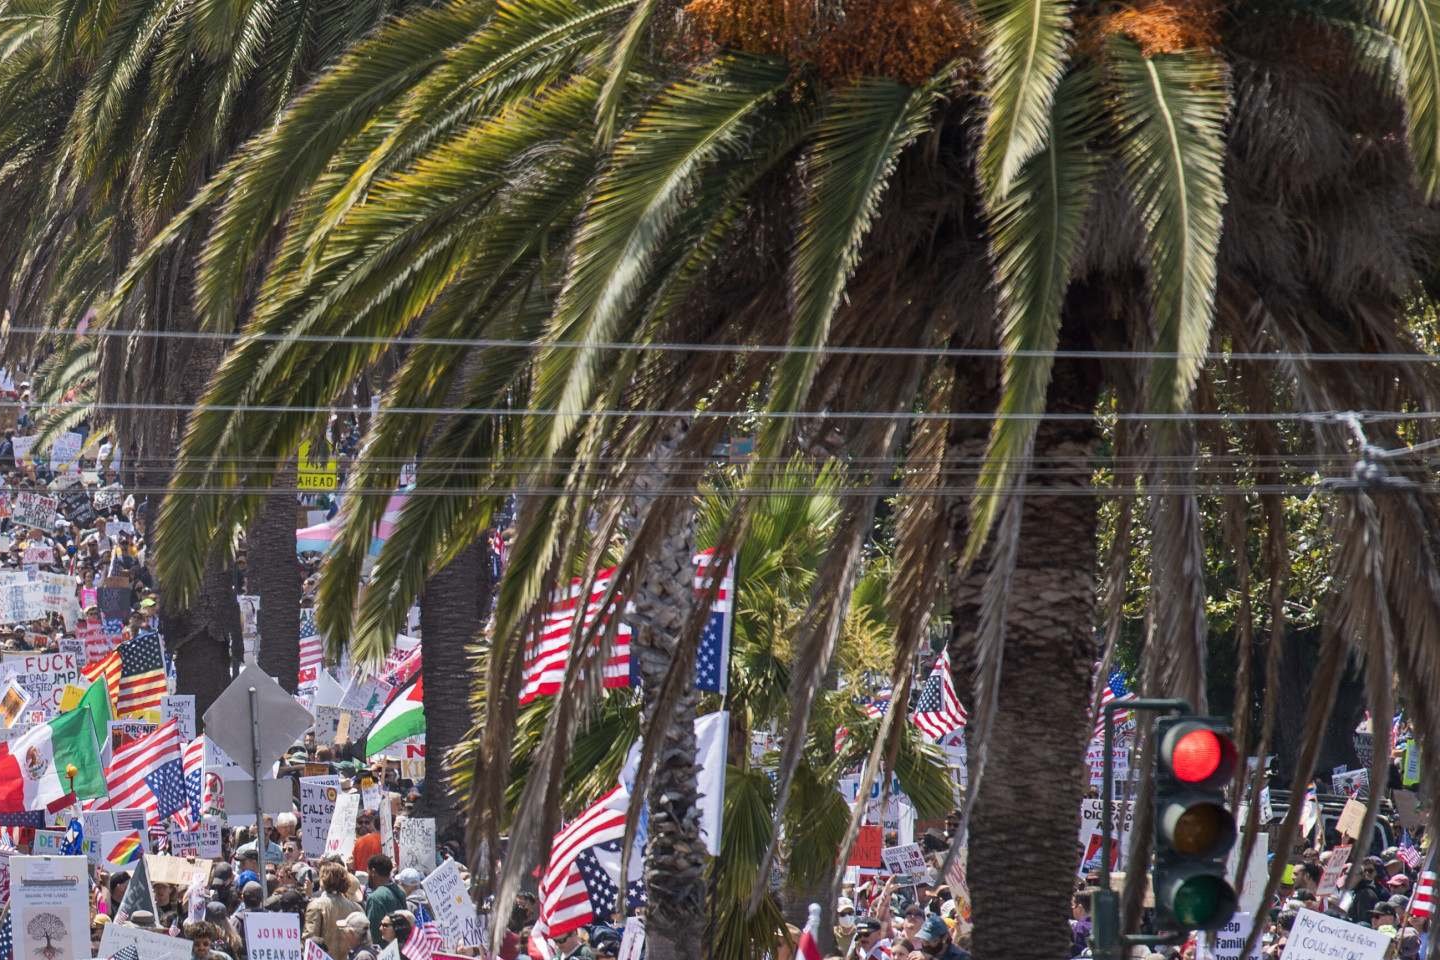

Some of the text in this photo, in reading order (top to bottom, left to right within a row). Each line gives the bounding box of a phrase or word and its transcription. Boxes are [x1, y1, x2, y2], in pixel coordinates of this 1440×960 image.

[297, 477, 334, 488] AHEAD
[25, 654, 74, 672] FUCK
[434, 875, 458, 899] TRUMP
[257, 927, 299, 939] JOIN US
[1223, 921, 1241, 933] eep
[251, 949, 300, 960] SPEAK UP
